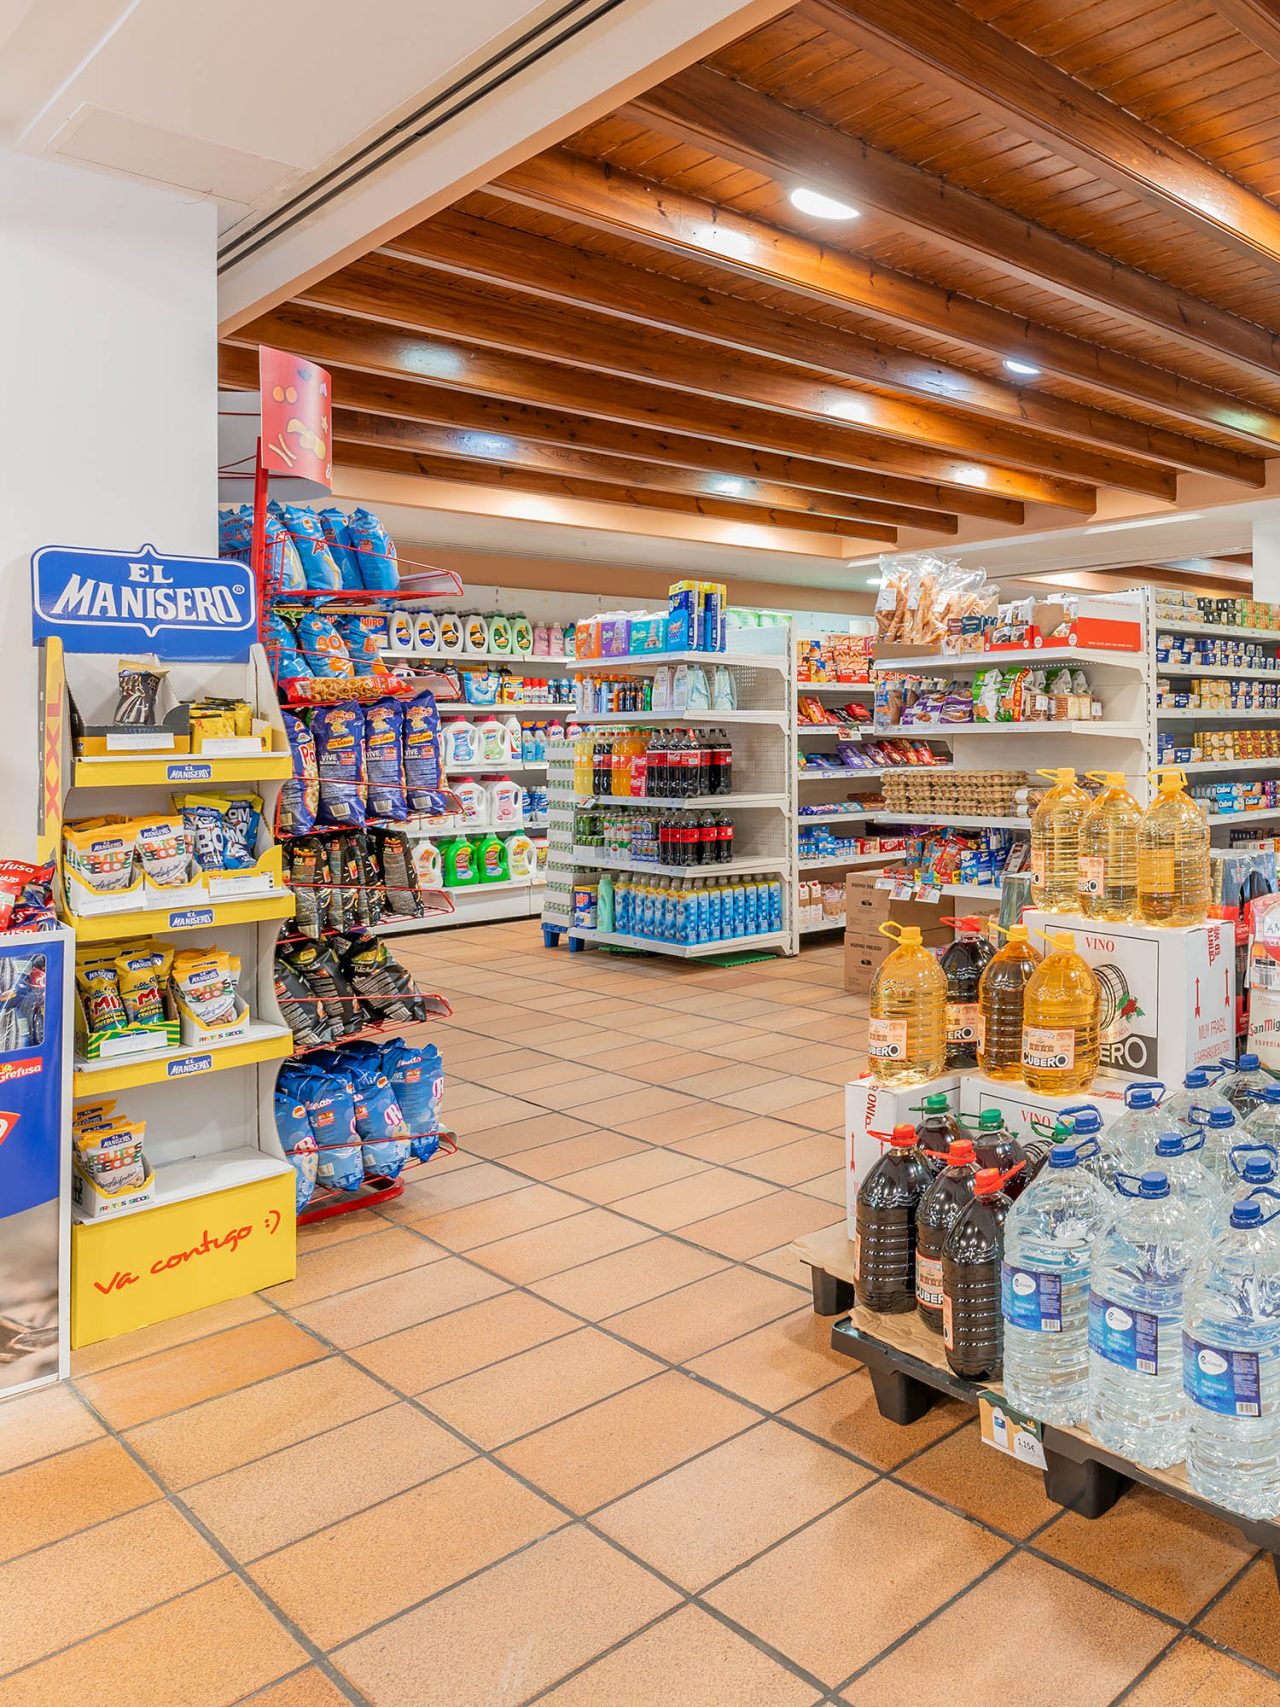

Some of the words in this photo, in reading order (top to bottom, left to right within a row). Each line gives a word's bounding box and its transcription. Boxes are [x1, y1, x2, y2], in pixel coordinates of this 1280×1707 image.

[128, 563, 174, 585] EL
[50, 573, 245, 625] MANISERO
[1085, 936, 1115, 953] VINO
[868, 1043, 901, 1058] UBERO
[1022, 1052, 1069, 1068] CUBERO
[1100, 1036, 1148, 1069] ERO
[1021, 1109, 1051, 1127] VINO
[94, 1271, 140, 1294] Va
[150, 1230, 253, 1275] contigo
